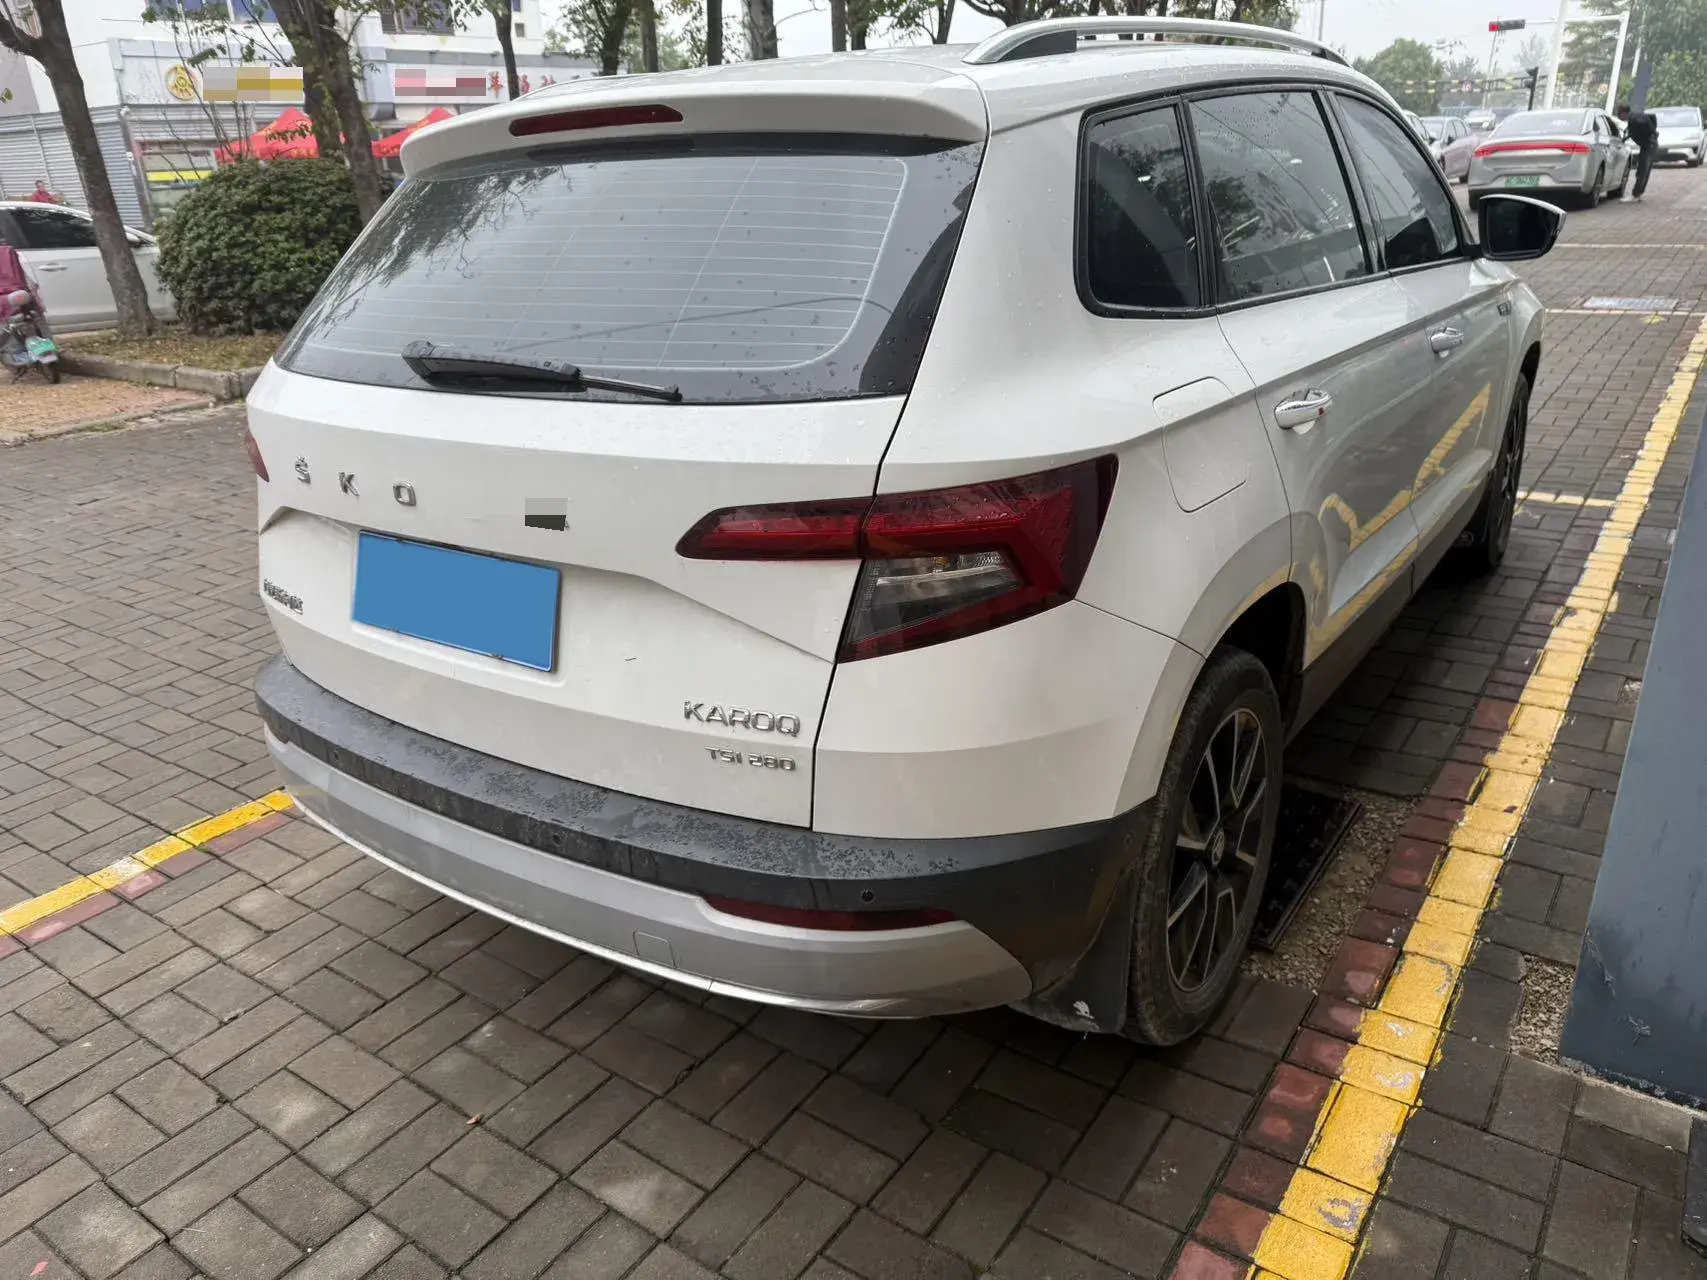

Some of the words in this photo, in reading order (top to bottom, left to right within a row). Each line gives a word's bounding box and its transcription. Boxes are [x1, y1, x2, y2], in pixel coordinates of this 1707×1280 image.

[683, 700, 801, 737] KAROQ
[704, 745, 743, 764] TSI
[748, 752, 796, 771] 280
